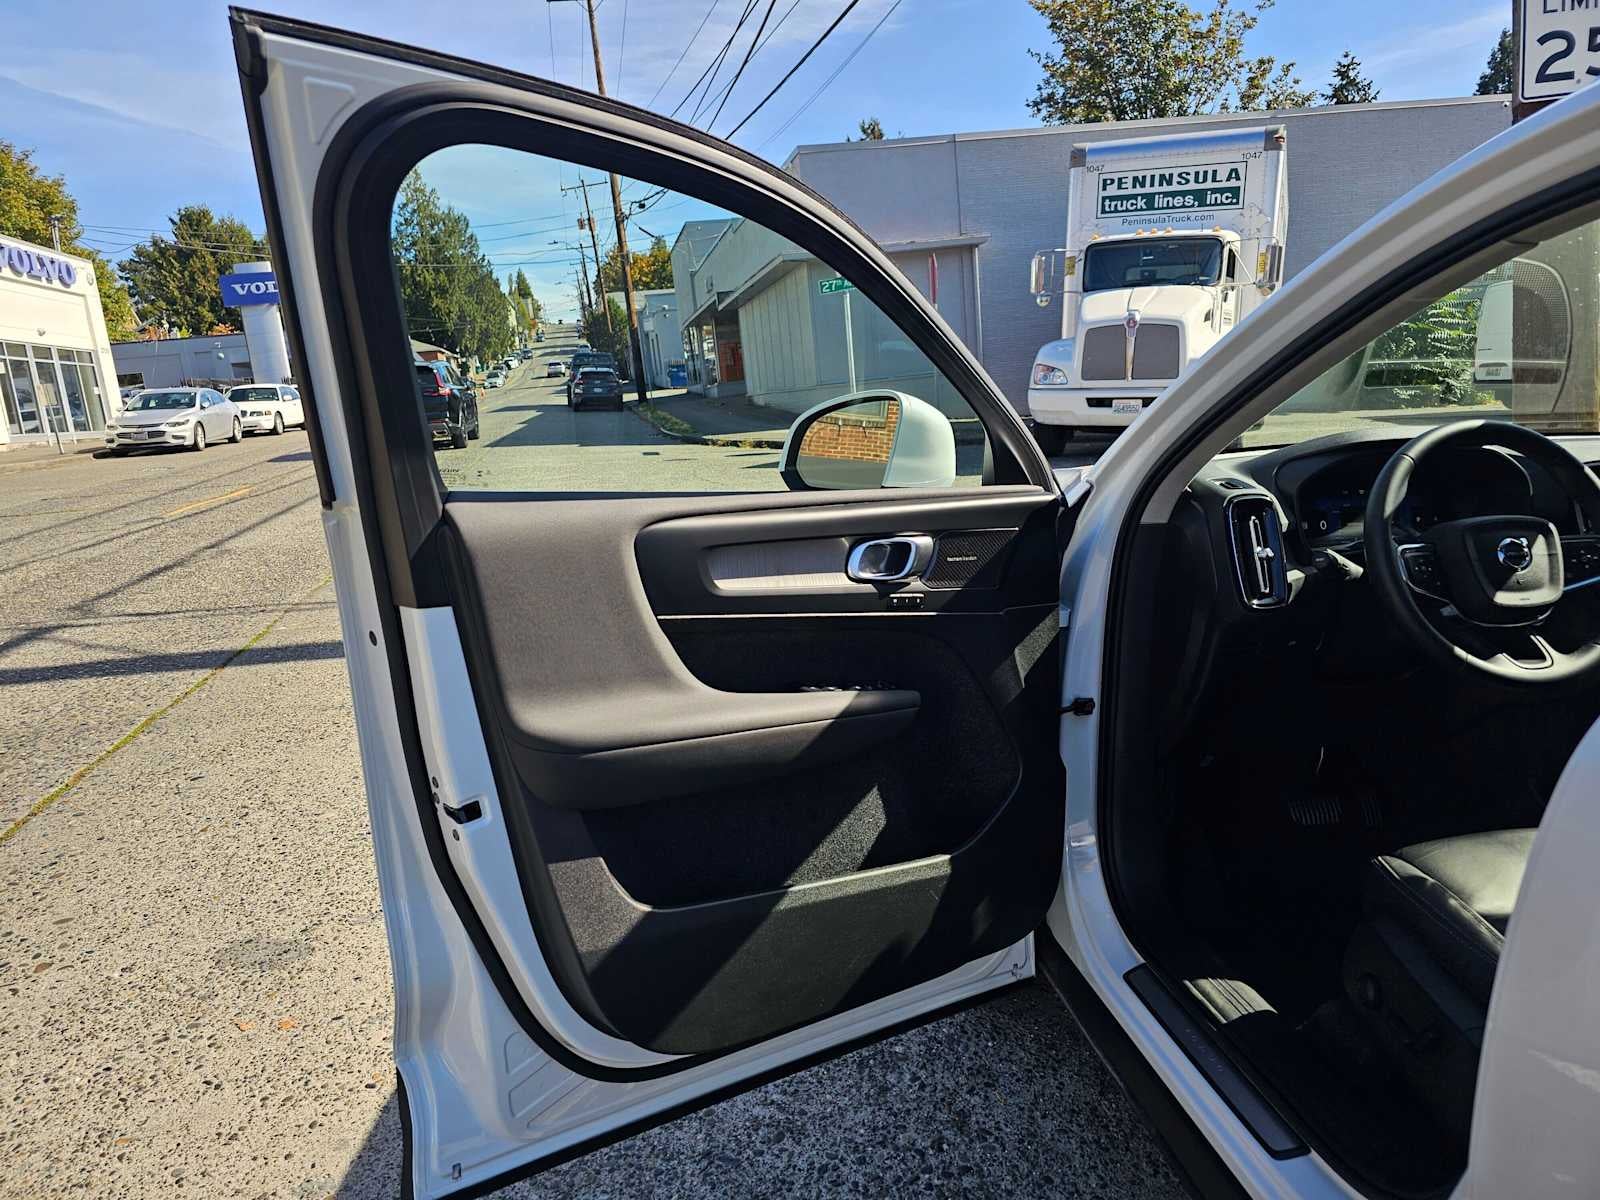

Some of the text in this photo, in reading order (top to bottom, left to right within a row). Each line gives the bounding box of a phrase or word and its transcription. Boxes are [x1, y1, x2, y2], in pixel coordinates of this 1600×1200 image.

[1543, 0, 1600, 14] LIMI
[1241, 151, 1263, 161] 1047
[1086, 164, 1105, 174] 1047
[1102, 167, 1241, 191] PENINSULA
[1104, 191, 1237, 211] truck lines, inc.
[1121, 213, 1215, 226] PeninsulaTruck.com
[231, 281, 279, 295] VOL
